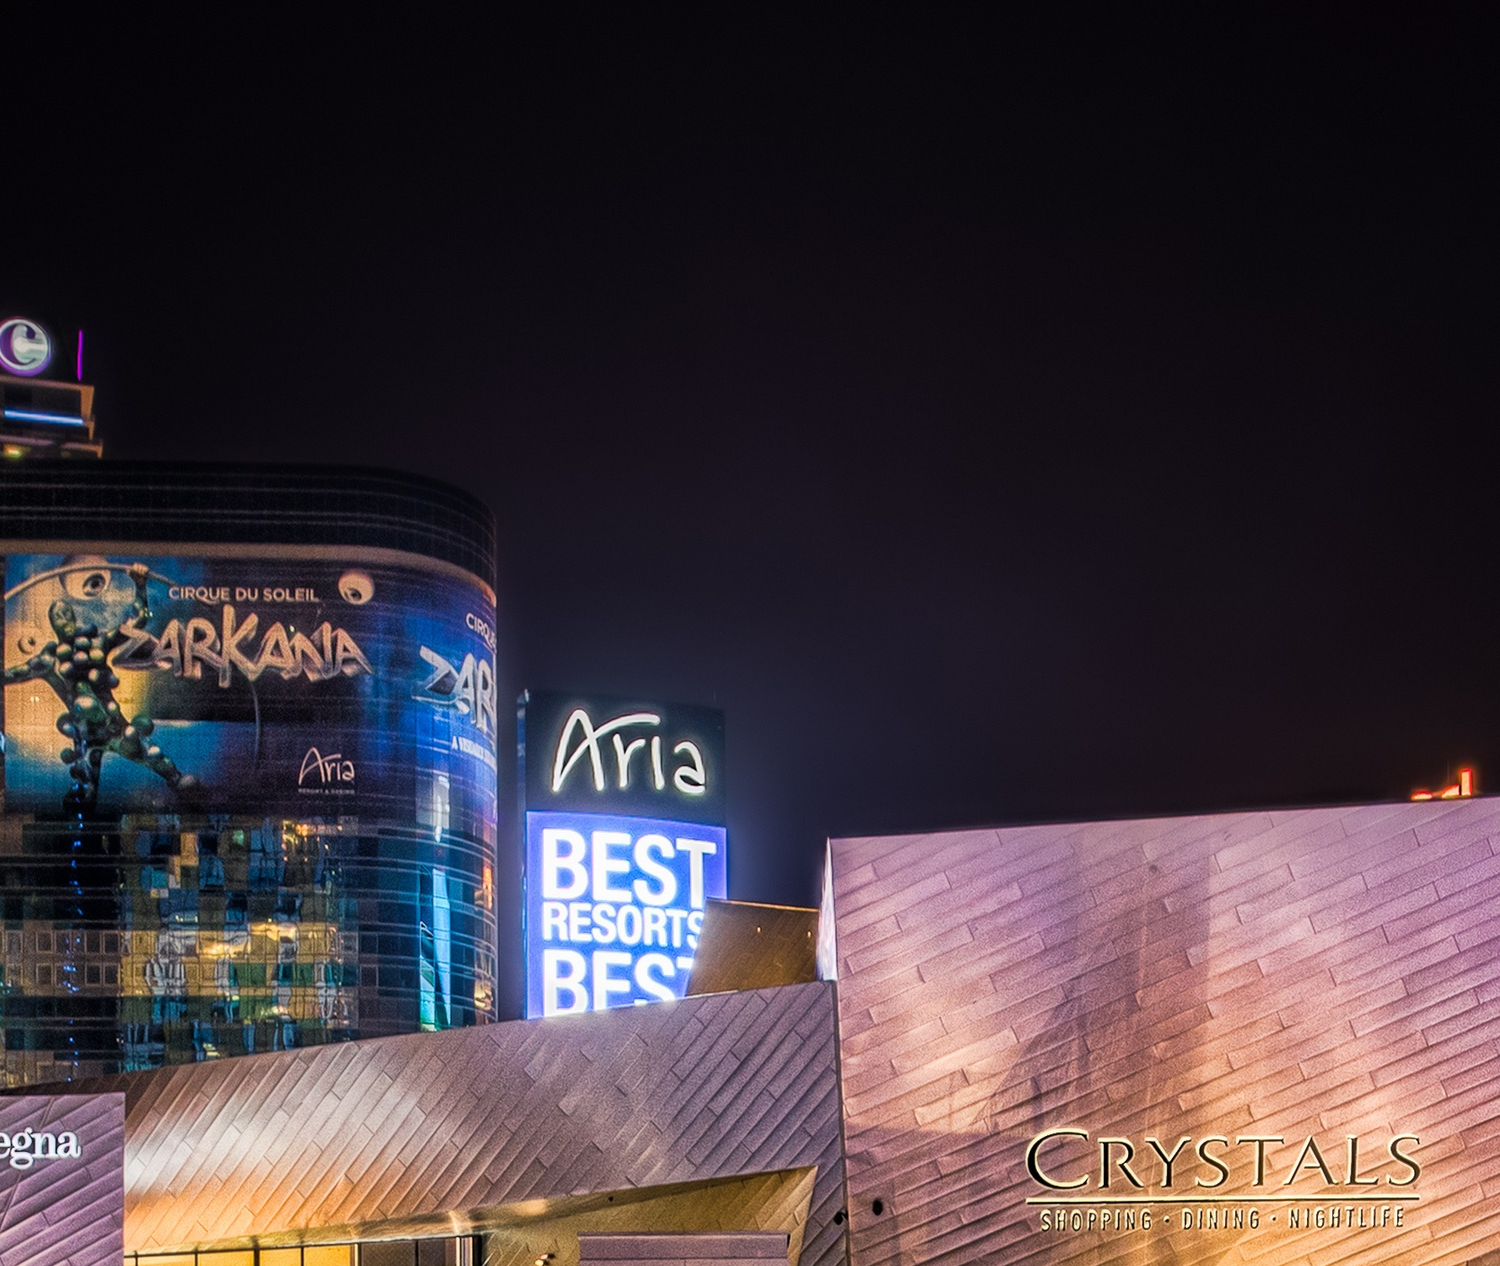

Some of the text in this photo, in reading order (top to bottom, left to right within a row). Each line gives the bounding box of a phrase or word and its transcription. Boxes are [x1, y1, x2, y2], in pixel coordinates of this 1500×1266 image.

[168, 586, 319, 604] CIRQUE DU SOLEIL
[298, 747, 355, 785] Aria
[551, 708, 707, 795] Aria
[541, 828, 717, 908] BEST
[541, 901, 705, 949] RESORTS
[541, 949, 697, 1018] BES
[1025, 1127, 1423, 1191] CRYSTALS
[1039, 1203, 1406, 1233] SHOPPING DINING NIGHTLIFE
